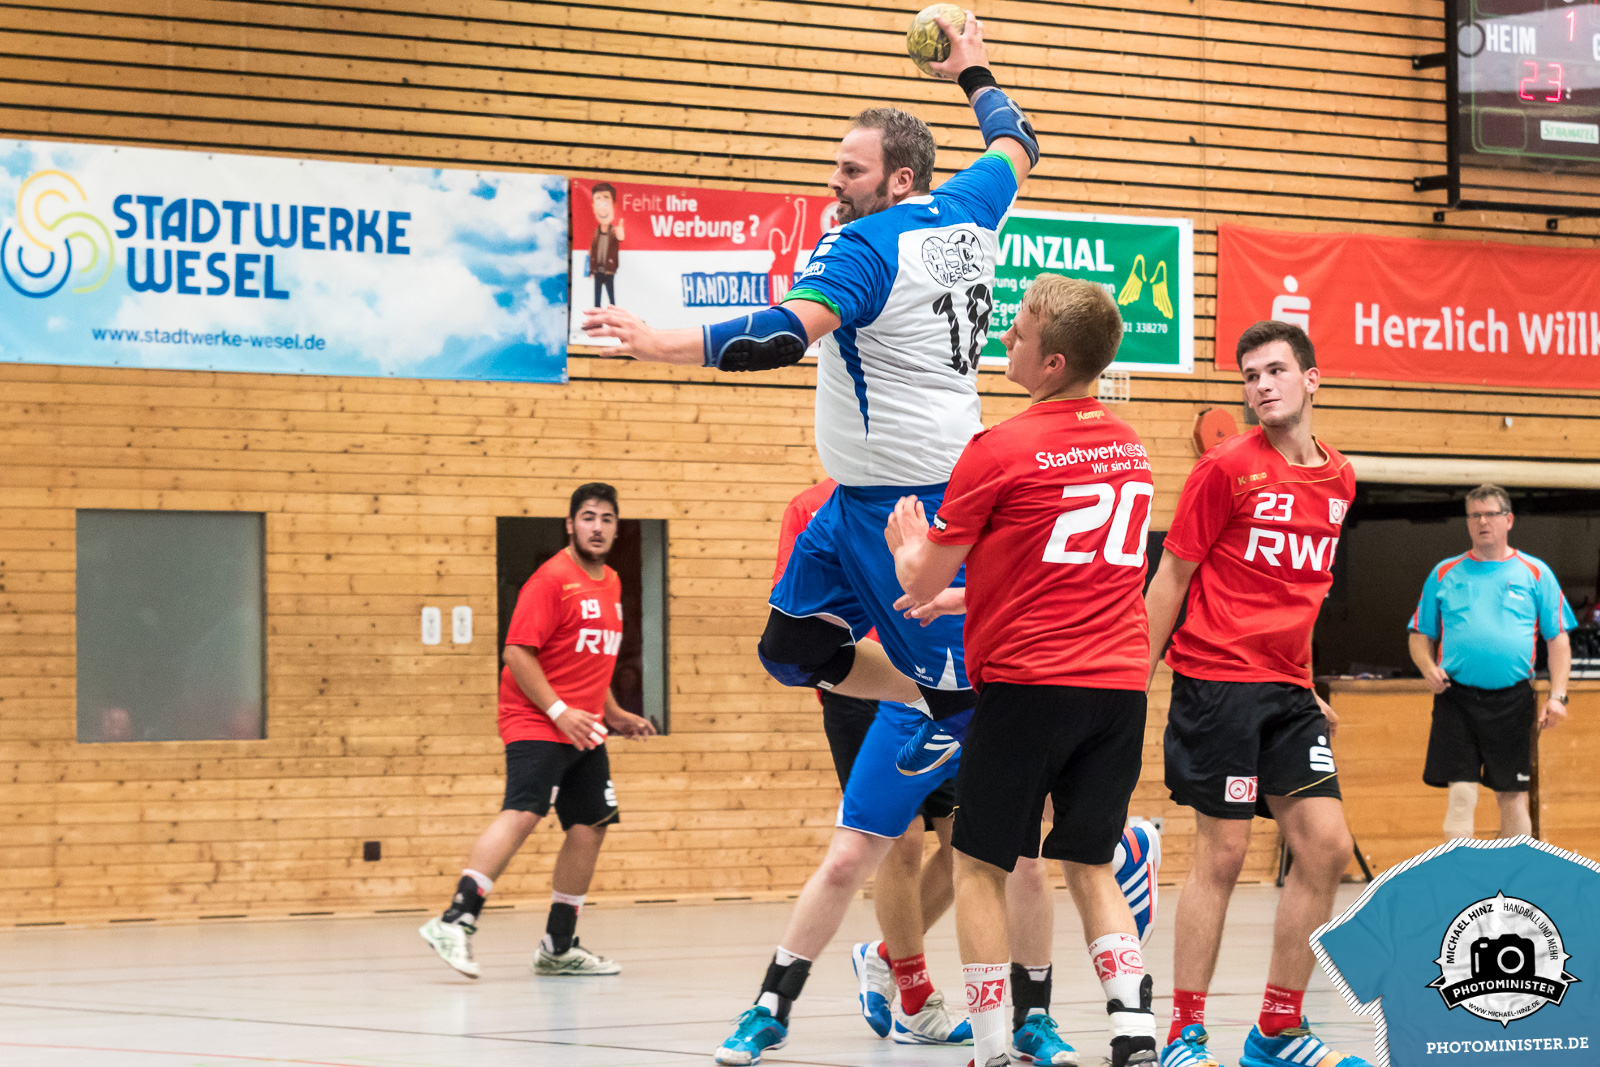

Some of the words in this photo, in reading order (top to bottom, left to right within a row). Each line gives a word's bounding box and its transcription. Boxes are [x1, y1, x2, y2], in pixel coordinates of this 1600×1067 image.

[1485, 24, 1537, 55] HEIM
[1566, 10, 1576, 42] 1
[622, 193, 663, 213] Fehlt
[666, 194, 698, 213] Ihre
[113, 193, 412, 256] STADTWERKE
[650, 214, 746, 244] Werbung
[127, 247, 290, 300] WESEL
[940, 262, 973, 284] WESEL
[683, 273, 769, 305] HANDBALL
[772, 274, 789, 305] IN
[92, 325, 326, 351] www.stadtwerke-wesel.de
[932, 283, 992, 376] 18
[1135, 322, 1169, 334] 338270
[1355, 302, 1509, 354] Herzlich
[1076, 408, 1106, 422] Kempa
[1091, 462, 1109, 475] Wir
[1110, 459, 1132, 472] sind
[1253, 492, 1295, 522] 23
[1041, 480, 1155, 568] 20
[579, 598, 601, 620] 19
